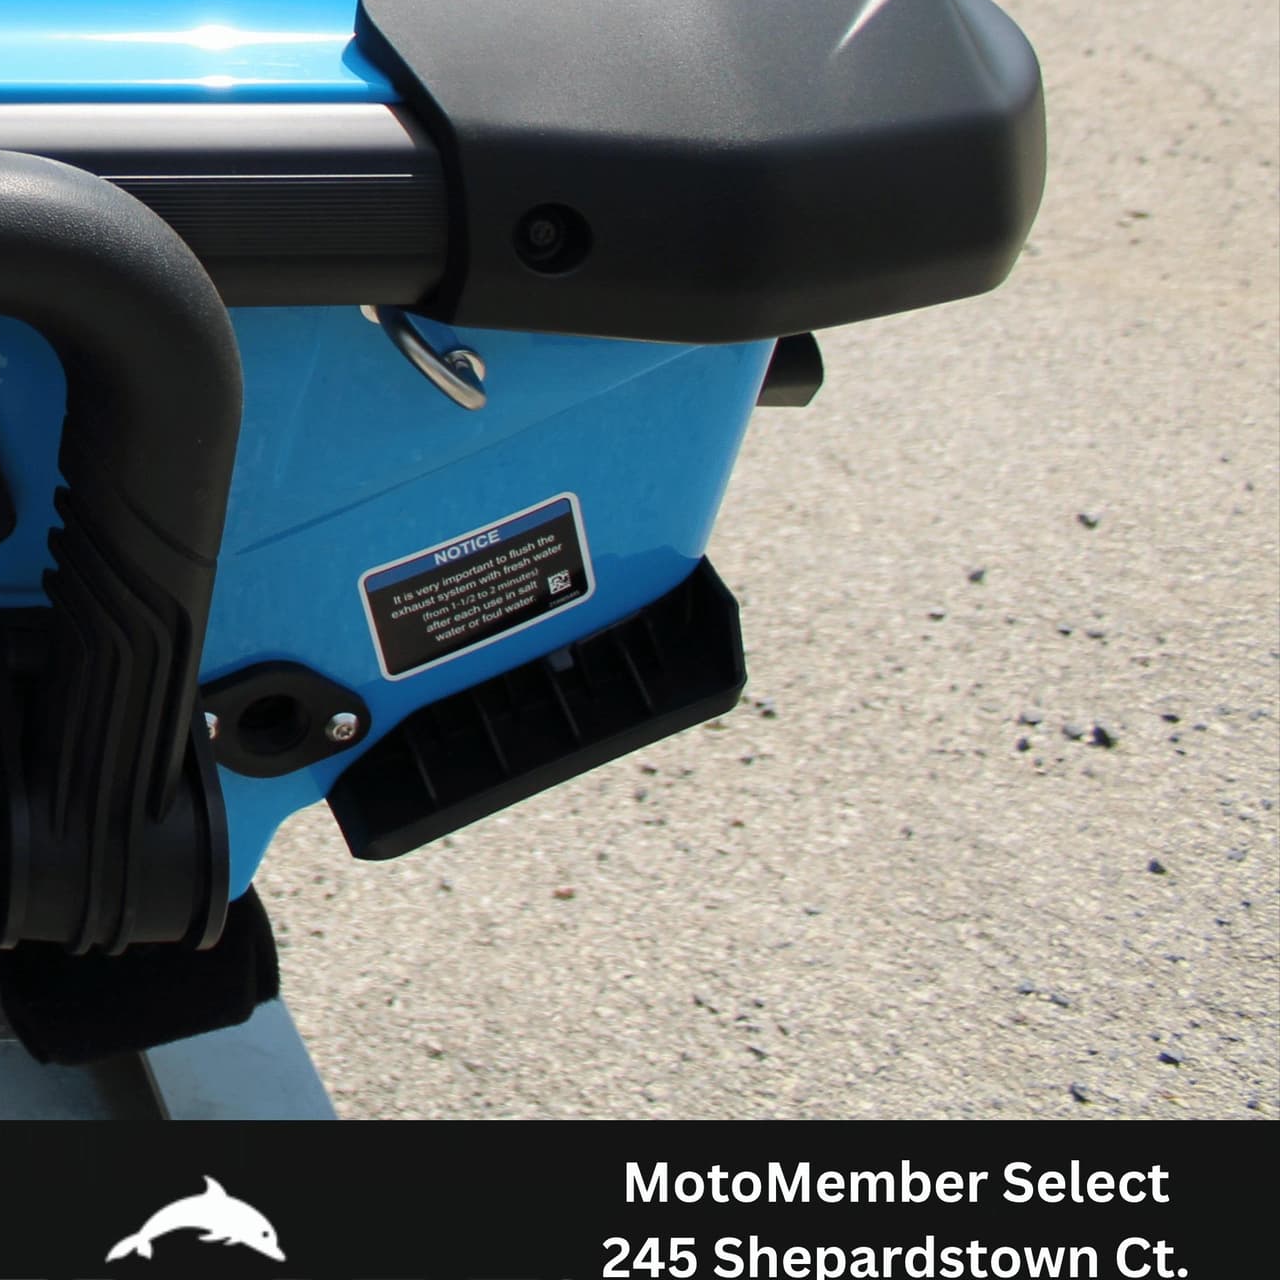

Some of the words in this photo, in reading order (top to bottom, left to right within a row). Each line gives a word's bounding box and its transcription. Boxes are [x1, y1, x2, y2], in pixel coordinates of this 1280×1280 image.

[392, 595, 402, 605] It
[402, 591, 414, 600] is
[416, 582, 439, 597] very
[441, 558, 493, 587] important
[495, 553, 507, 564] to
[509, 542, 535, 558] flush
[536, 532, 555, 546] the
[434, 529, 501, 566] NOTICE
[390, 596, 434, 620] exhaust
[436, 579, 476, 602] system
[478, 569, 500, 583] with
[503, 556, 530, 573] fresh
[533, 543, 562, 560] water
[422, 604, 448, 621] (from
[451, 594, 475, 609] 1-1/2
[476, 588, 488, 599] to
[488, 585, 496, 594] 2
[497, 567, 538, 591] minutes)
[425, 617, 450, 632] after
[453, 605, 480, 621] each
[482, 596, 503, 610] use
[504, 589, 516, 600] in
[517, 580, 537, 594] salt
[436, 624, 466, 642] water
[467, 619, 479, 628] or
[482, 608, 502, 622] foul
[505, 595, 535, 612] water.
